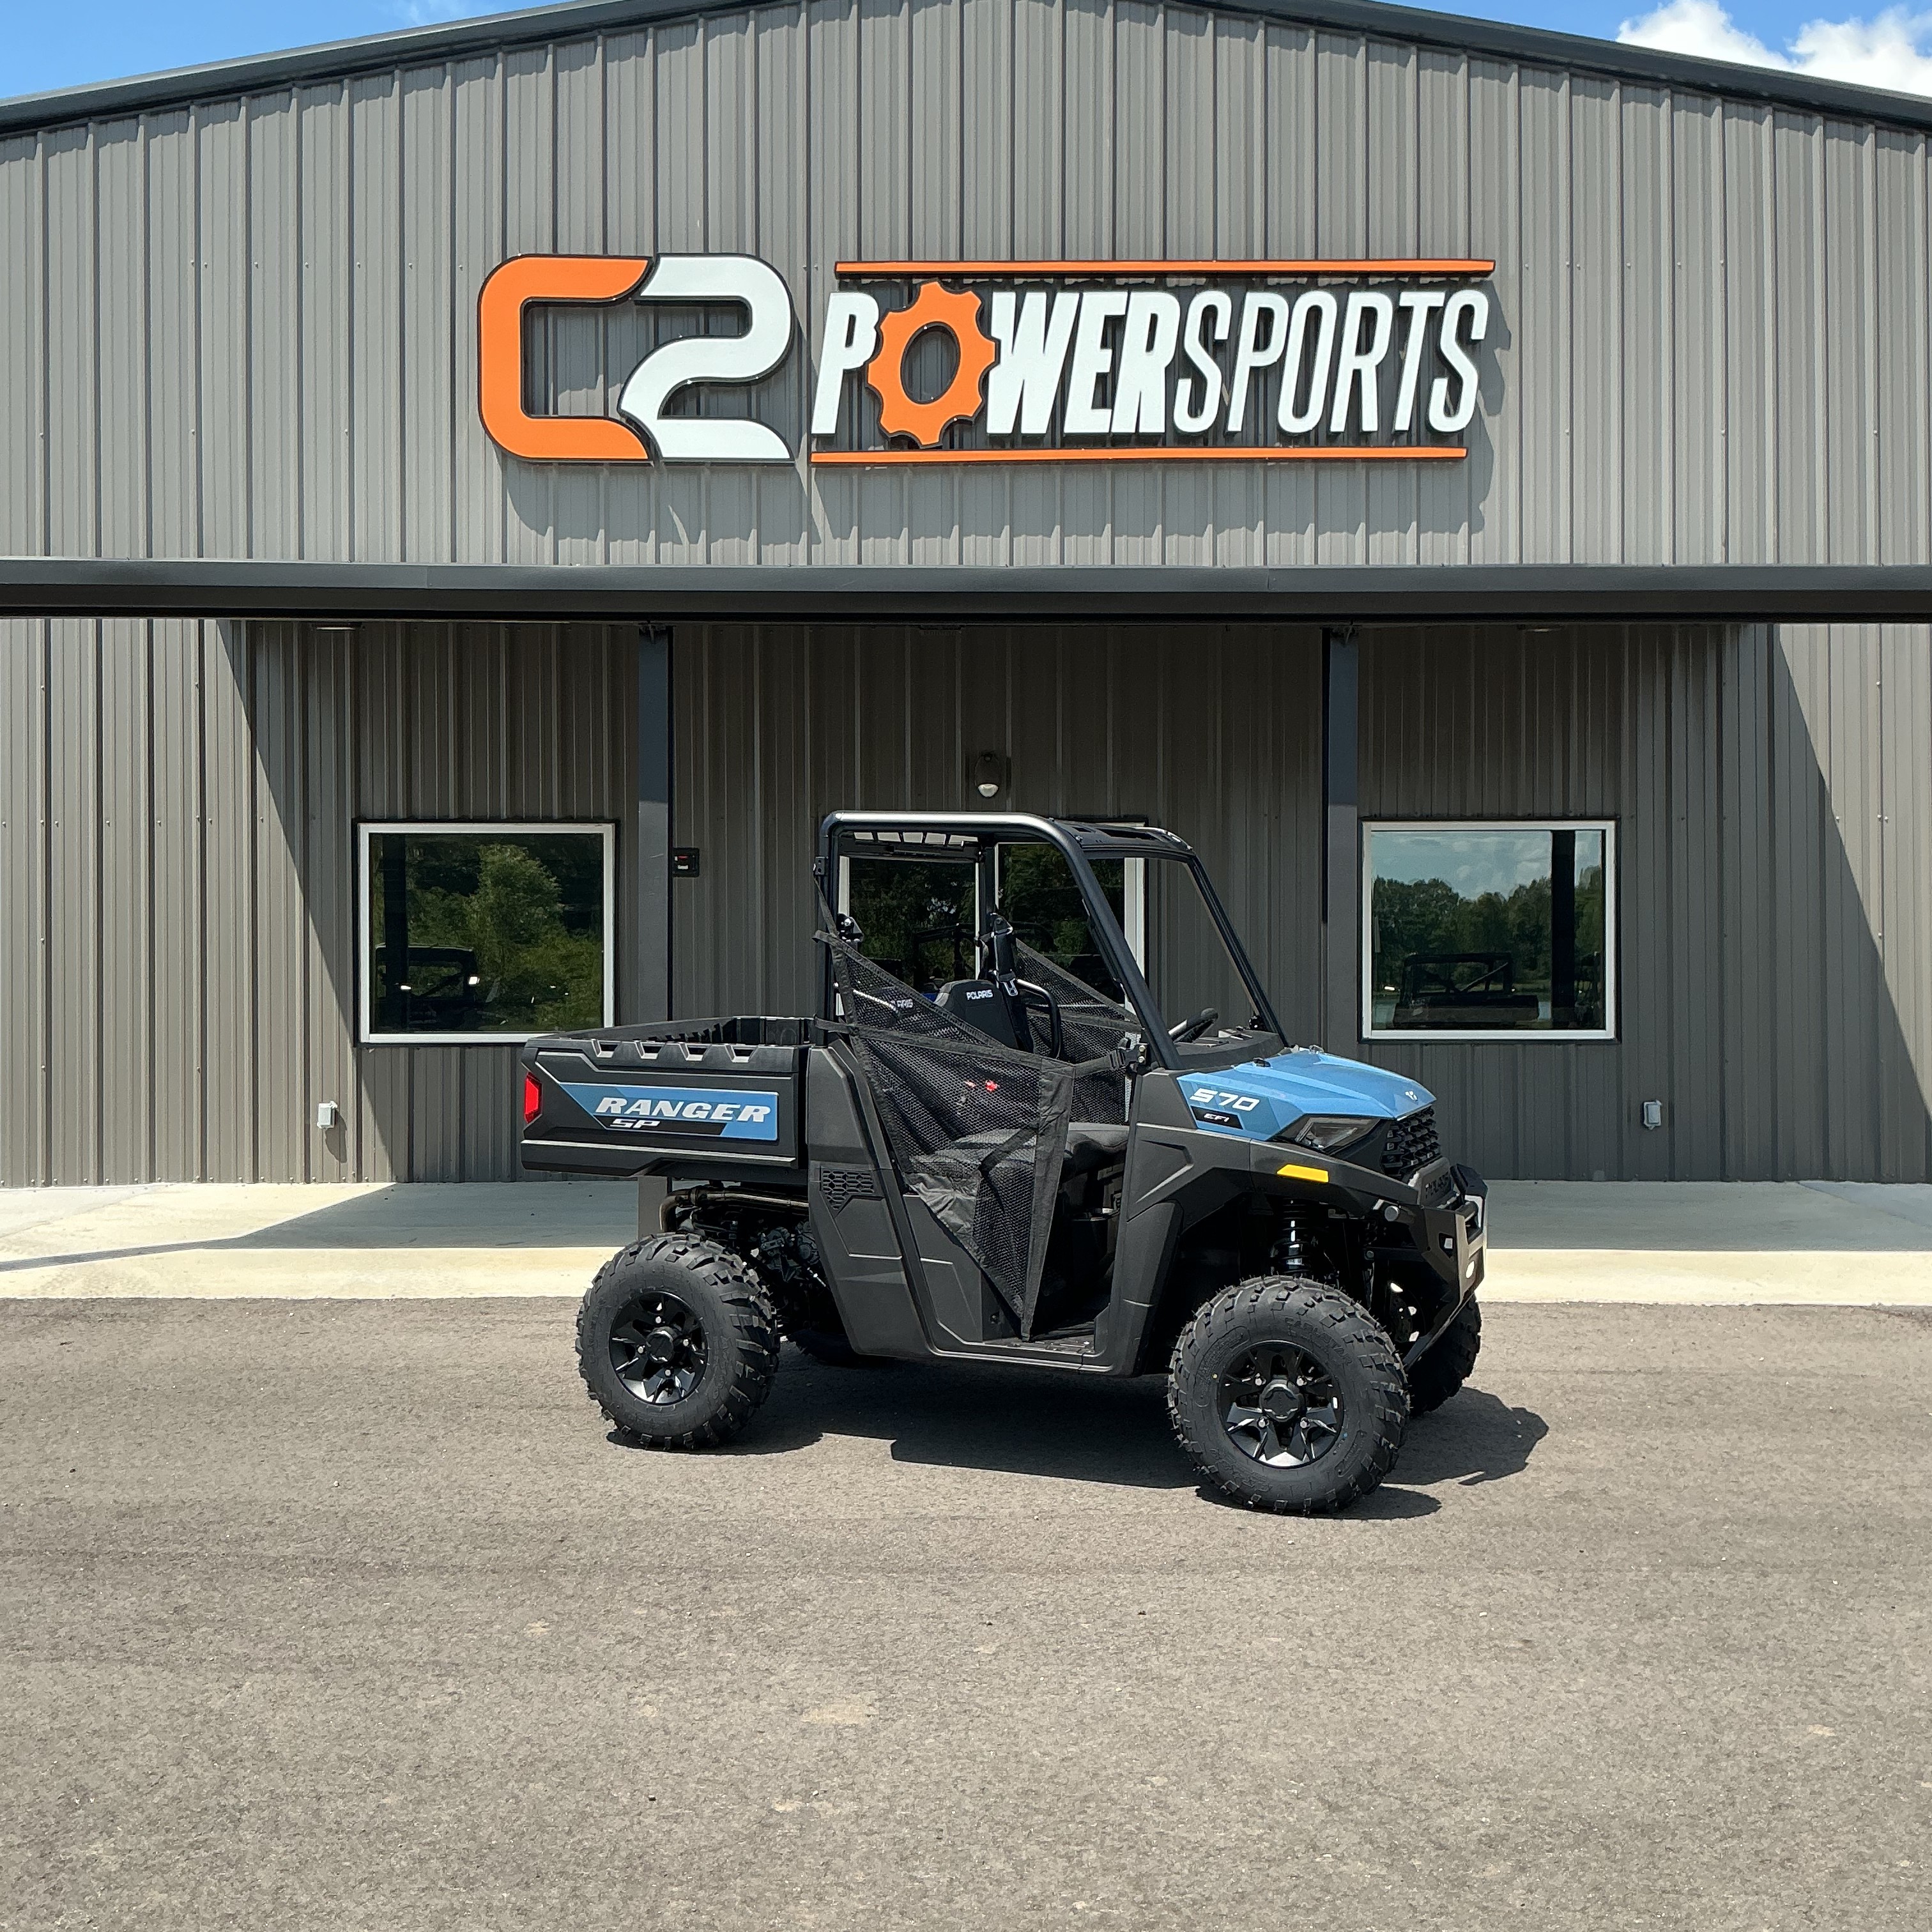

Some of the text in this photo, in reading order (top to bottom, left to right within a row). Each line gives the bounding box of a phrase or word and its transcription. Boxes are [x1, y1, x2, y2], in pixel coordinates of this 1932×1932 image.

[480, 255, 1489, 461] C2 POWERSPORTS
[967, 990, 993, 1000] POLARIS
[1189, 1087, 1261, 1112] 570
[595, 1096, 772, 1123] RANGER
[1204, 1113, 1230, 1122] EFI
[610, 1118, 661, 1130] SP
